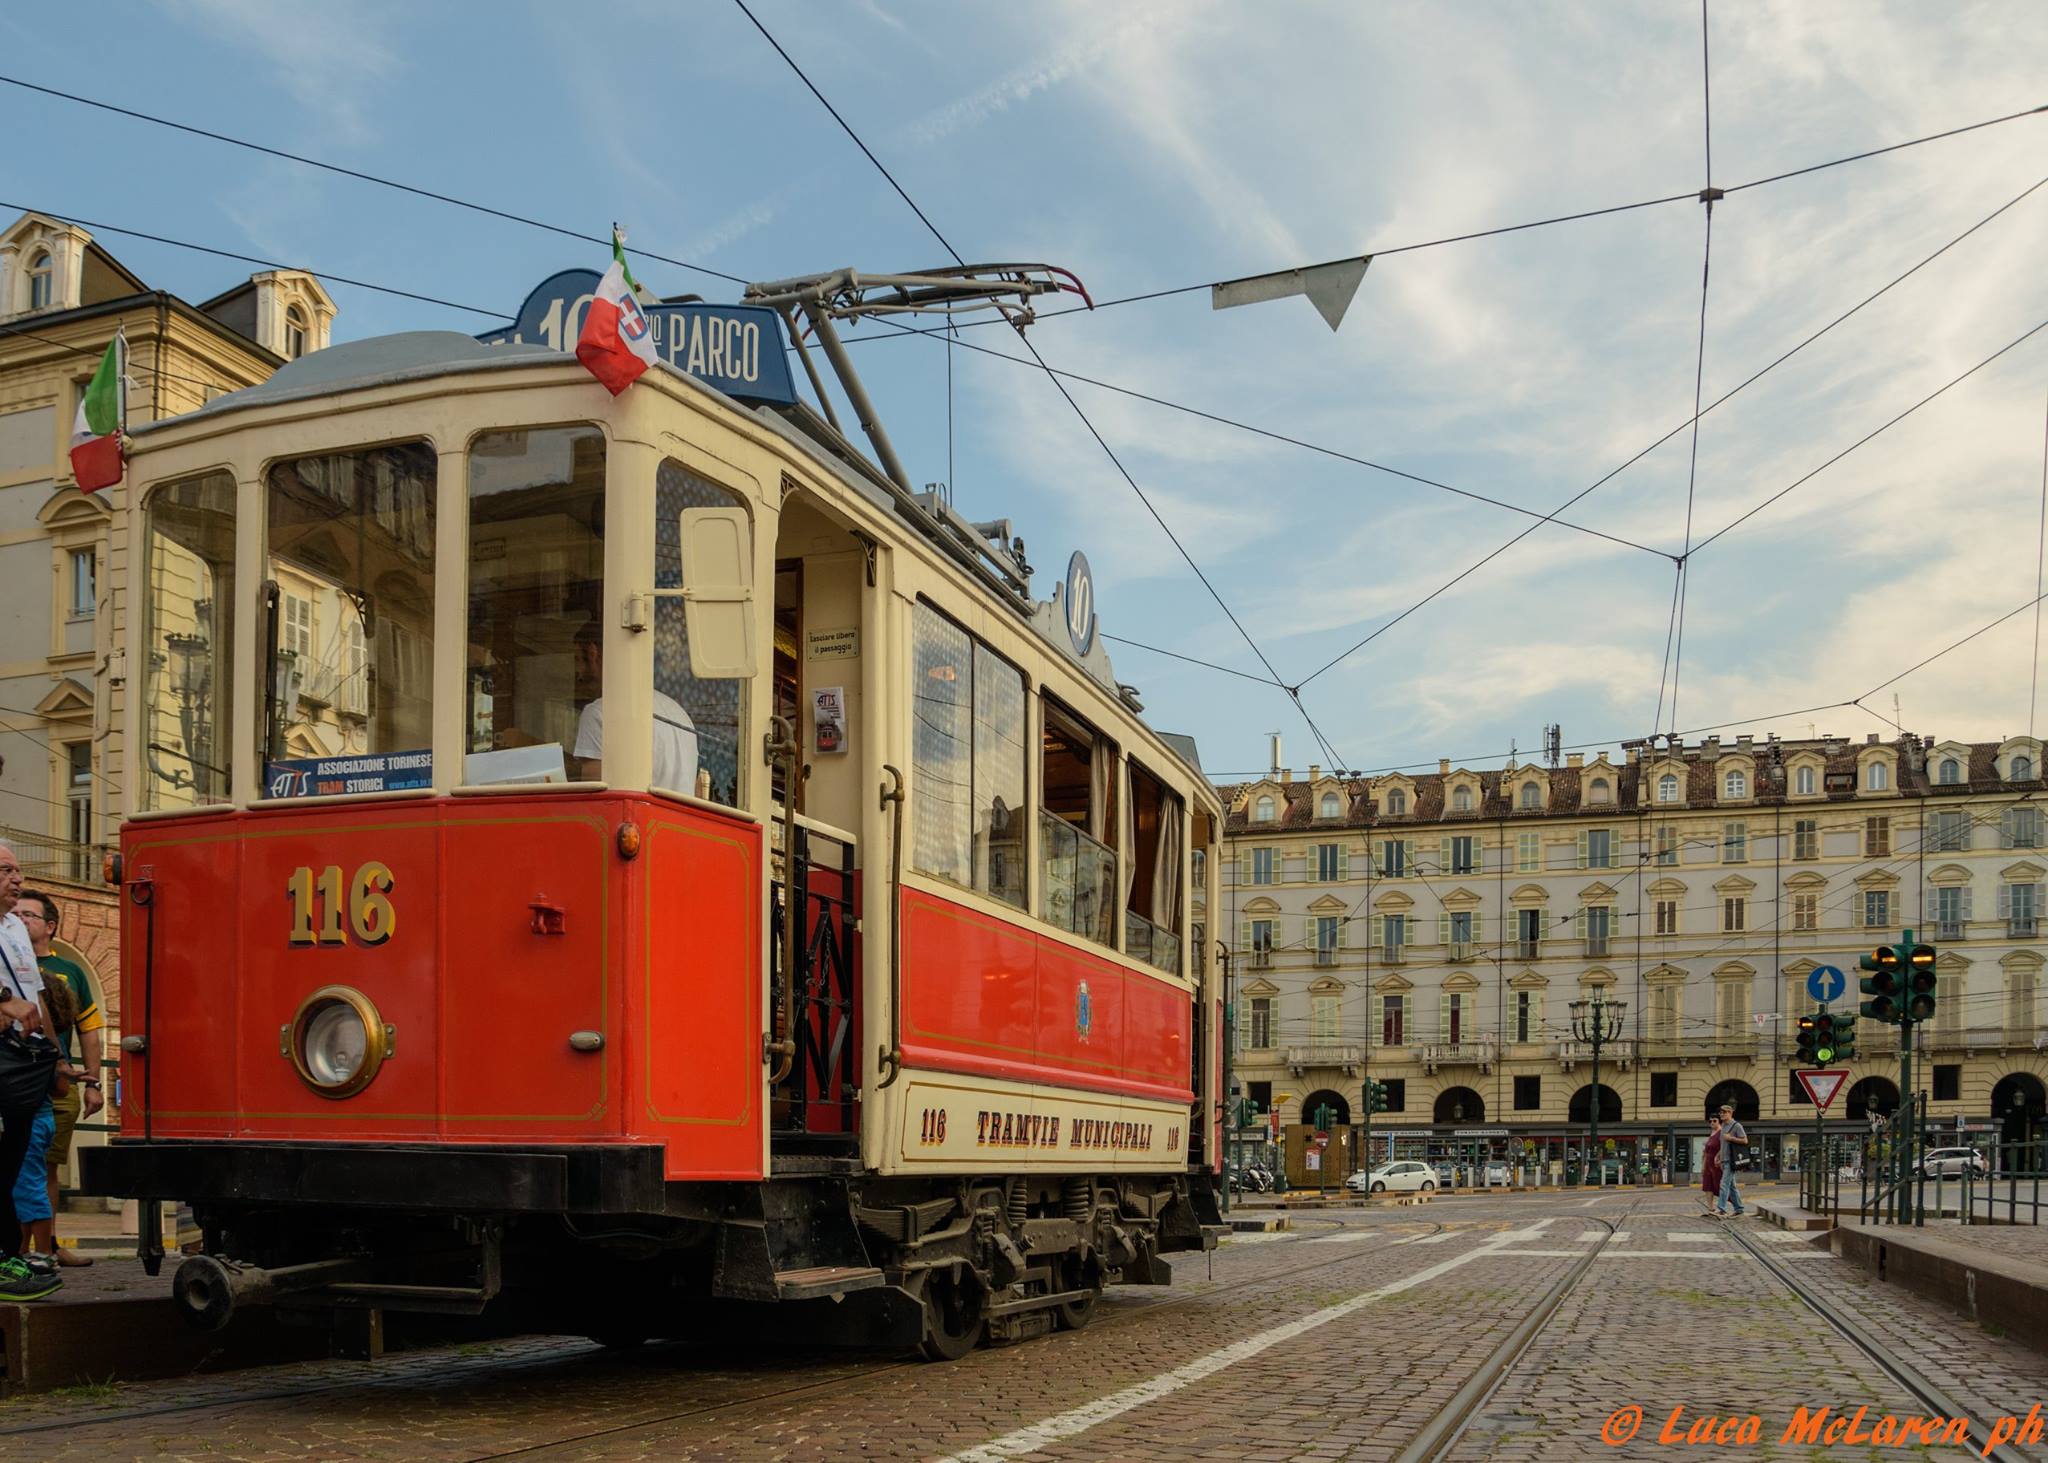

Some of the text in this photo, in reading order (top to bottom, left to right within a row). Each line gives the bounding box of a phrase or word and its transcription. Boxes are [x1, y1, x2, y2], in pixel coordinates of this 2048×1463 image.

[669, 313, 759, 382] PARCO
[1071, 568, 1089, 640] 10
[820, 643, 852, 654] passaggio
[317, 754, 432, 775] ASSOCIAZIONE TORINESE
[270, 770, 312, 798] ATTS
[317, 781, 344, 794] TRAM
[346, 777, 384, 793] STORICI
[288, 861, 396, 946] 116
[920, 1108, 1179, 1151] 116 TRAMVIE MUNICIPALI 116
